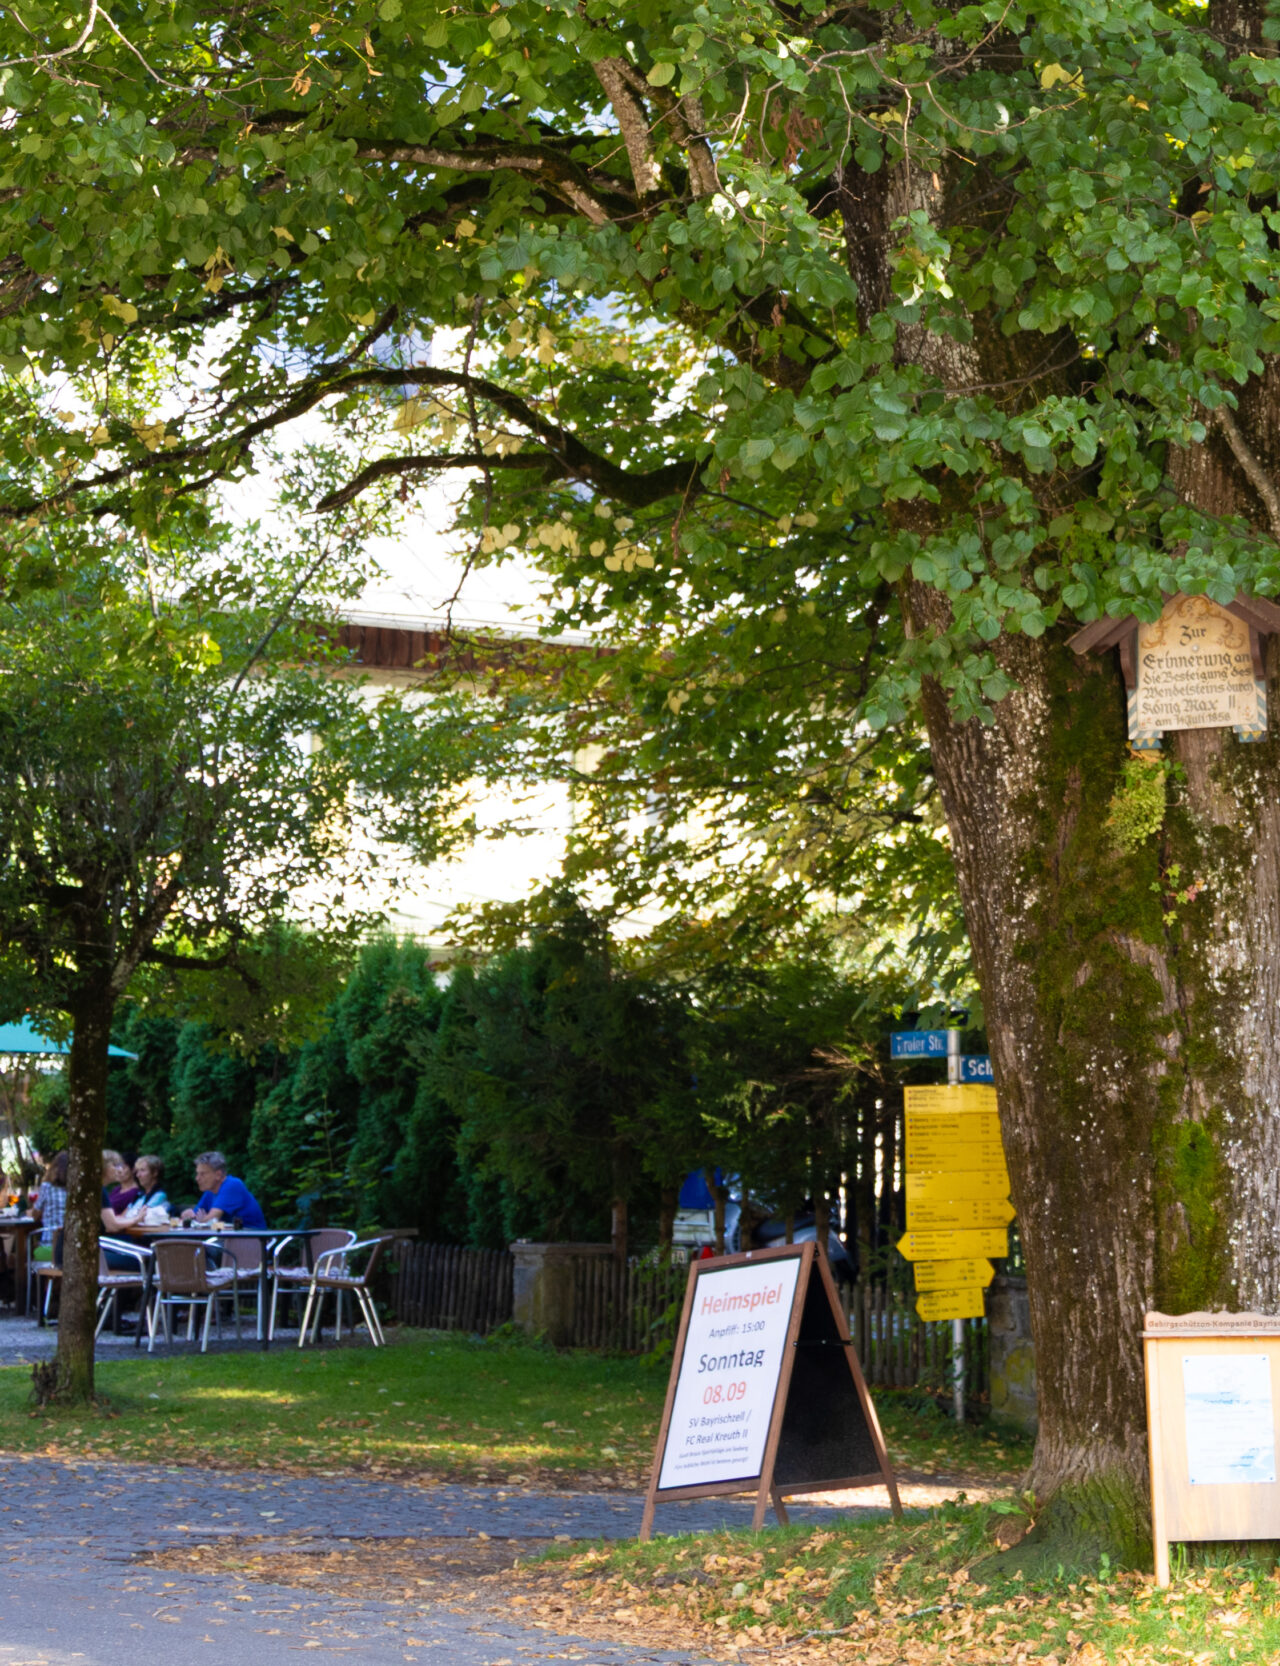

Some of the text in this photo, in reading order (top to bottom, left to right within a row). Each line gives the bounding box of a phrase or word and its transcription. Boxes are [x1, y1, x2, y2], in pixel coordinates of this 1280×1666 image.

[1179, 625, 1207, 647] Zur
[1143, 651, 1250, 670] Erinnerung an
[1143, 666, 1252, 685] die Besteigung des
[1142, 679, 1254, 699] Wendelsteins durch
[1142, 699, 1182, 716] König
[1183, 698, 1219, 713] Max
[1155, 717, 1172, 727] am
[928, 1034, 944, 1051] Str.
[700, 1283, 783, 1316] Heimspiel
[709, 1320, 766, 1339] Anpfiff: 15:00
[698, 1348, 766, 1374] Sonntag
[703, 1381, 747, 1406] 08.09
[688, 1416, 699, 1429] SV
[700, 1410, 746, 1428] Bayrischzell
[685, 1433, 697, 1446] FC
[696, 1431, 713, 1445] Real
[714, 1428, 741, 1443] Kreuth
